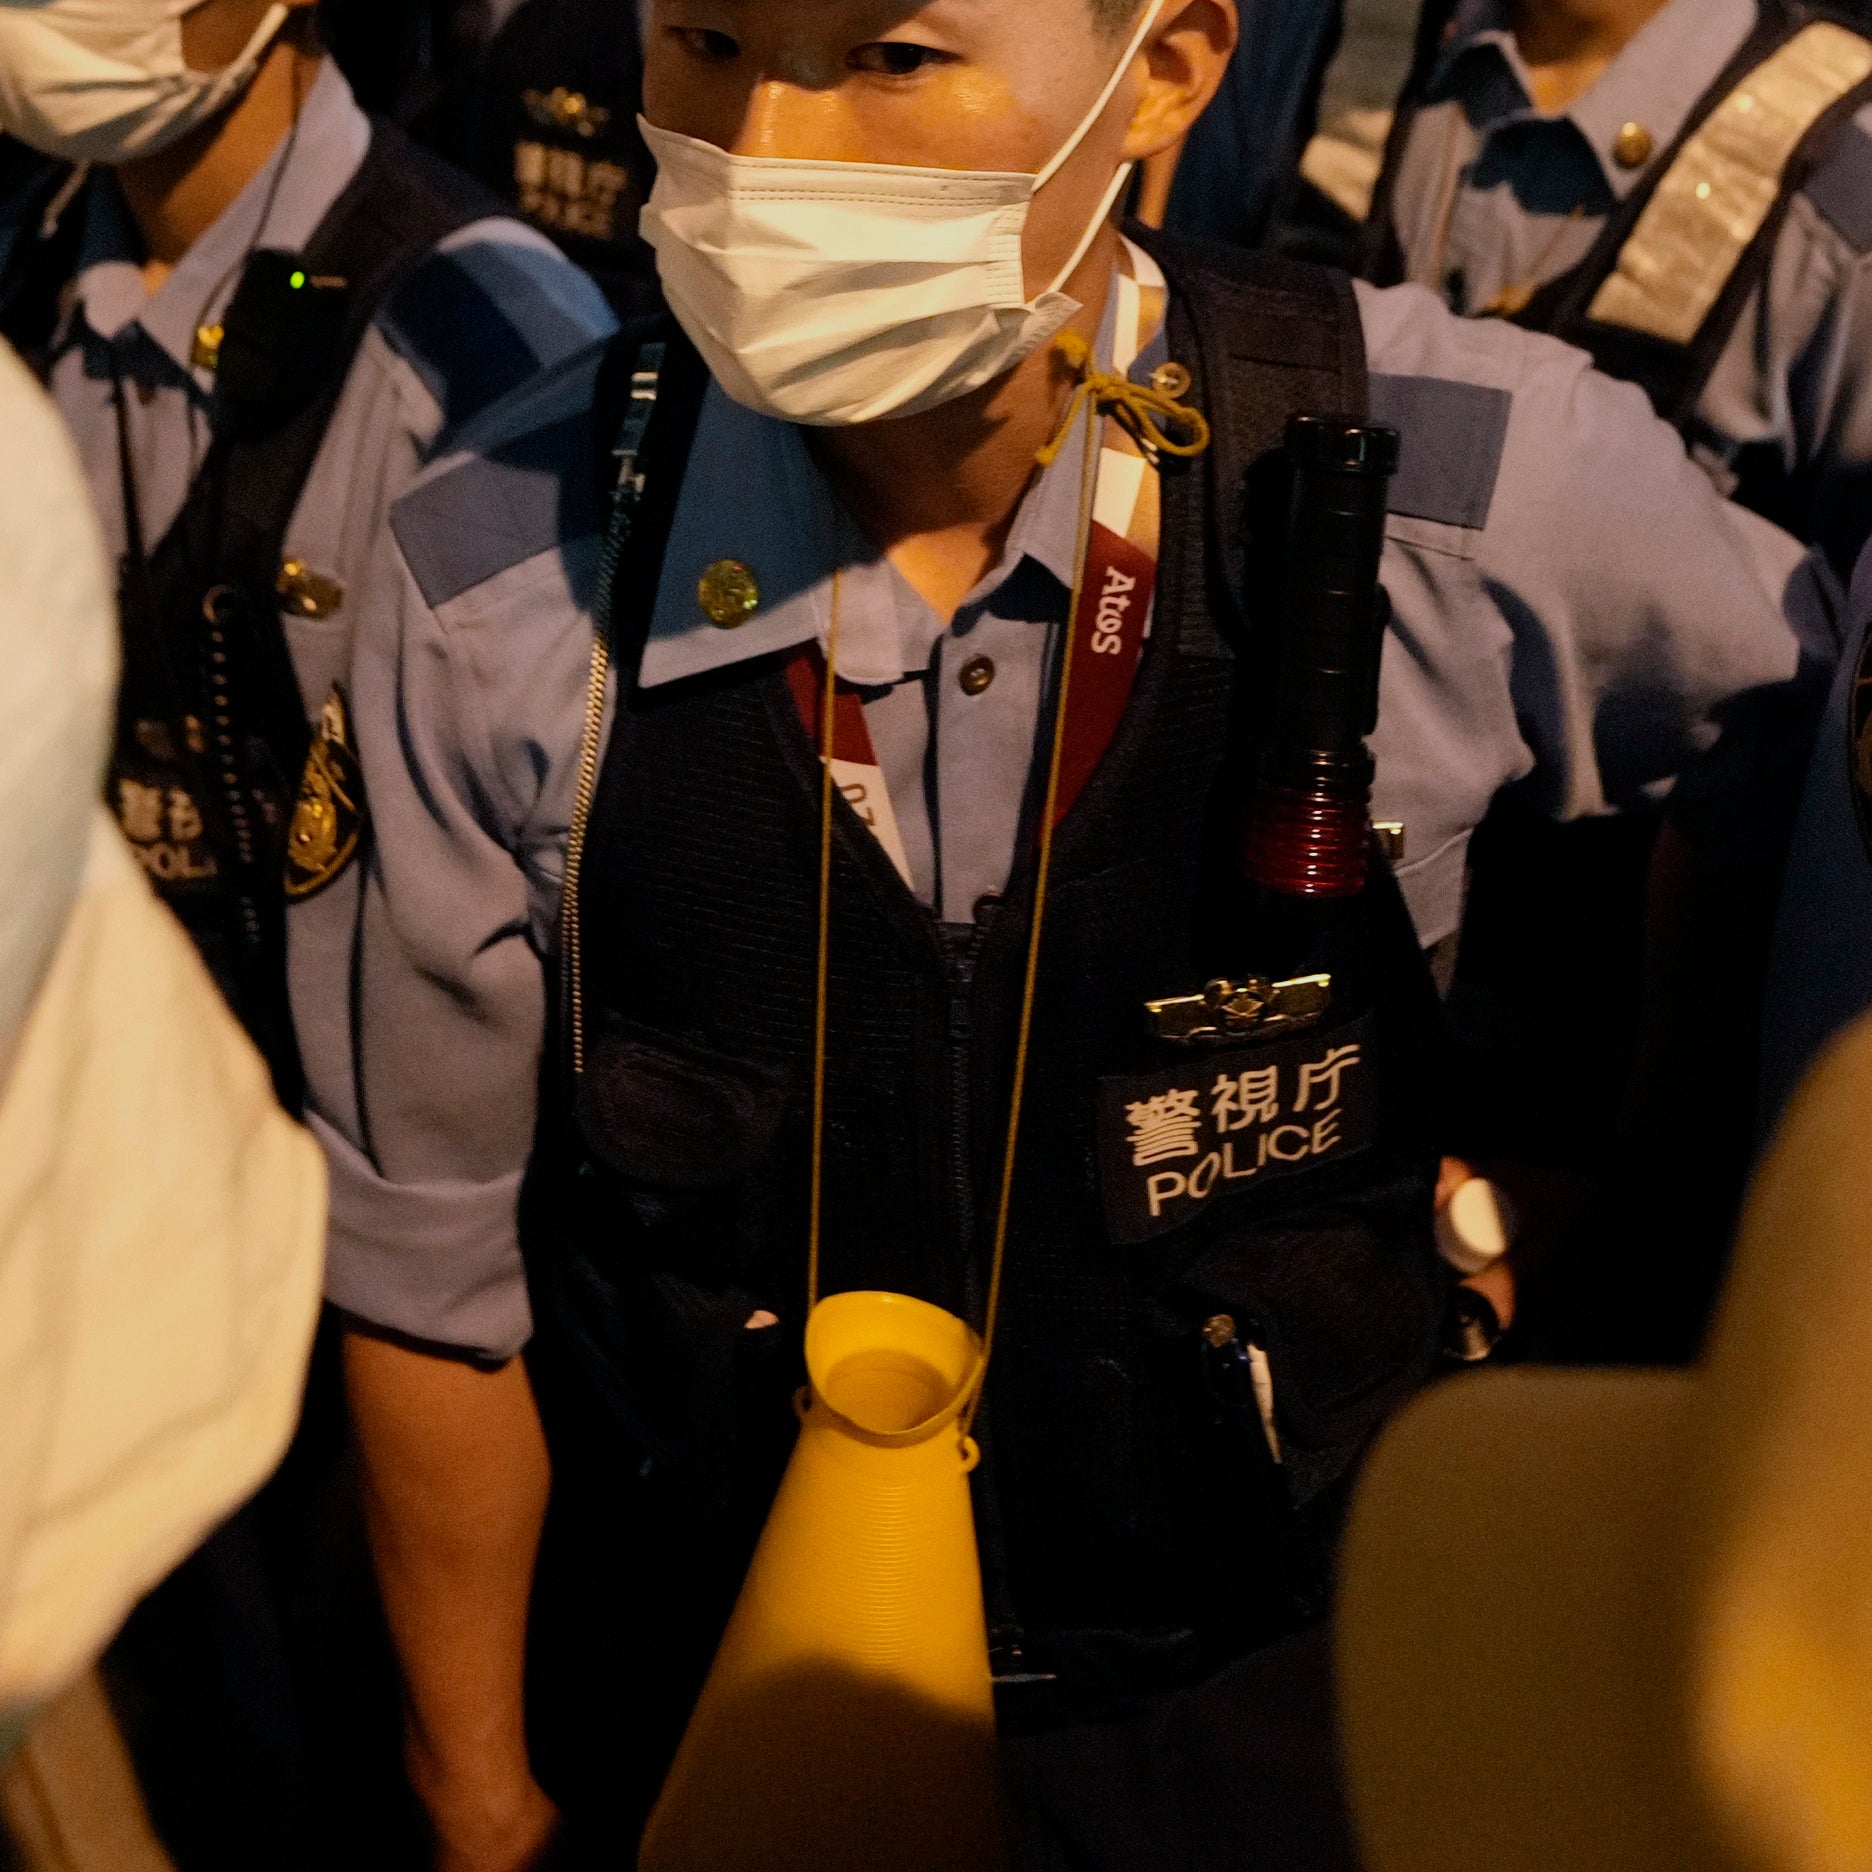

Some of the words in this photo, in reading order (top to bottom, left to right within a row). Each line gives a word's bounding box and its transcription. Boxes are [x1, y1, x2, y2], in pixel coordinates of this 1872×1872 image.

[1090, 565, 1137, 656] Atos
[1124, 1042, 1362, 1169] 警視庁
[1145, 1107, 1342, 1218] POLICE
